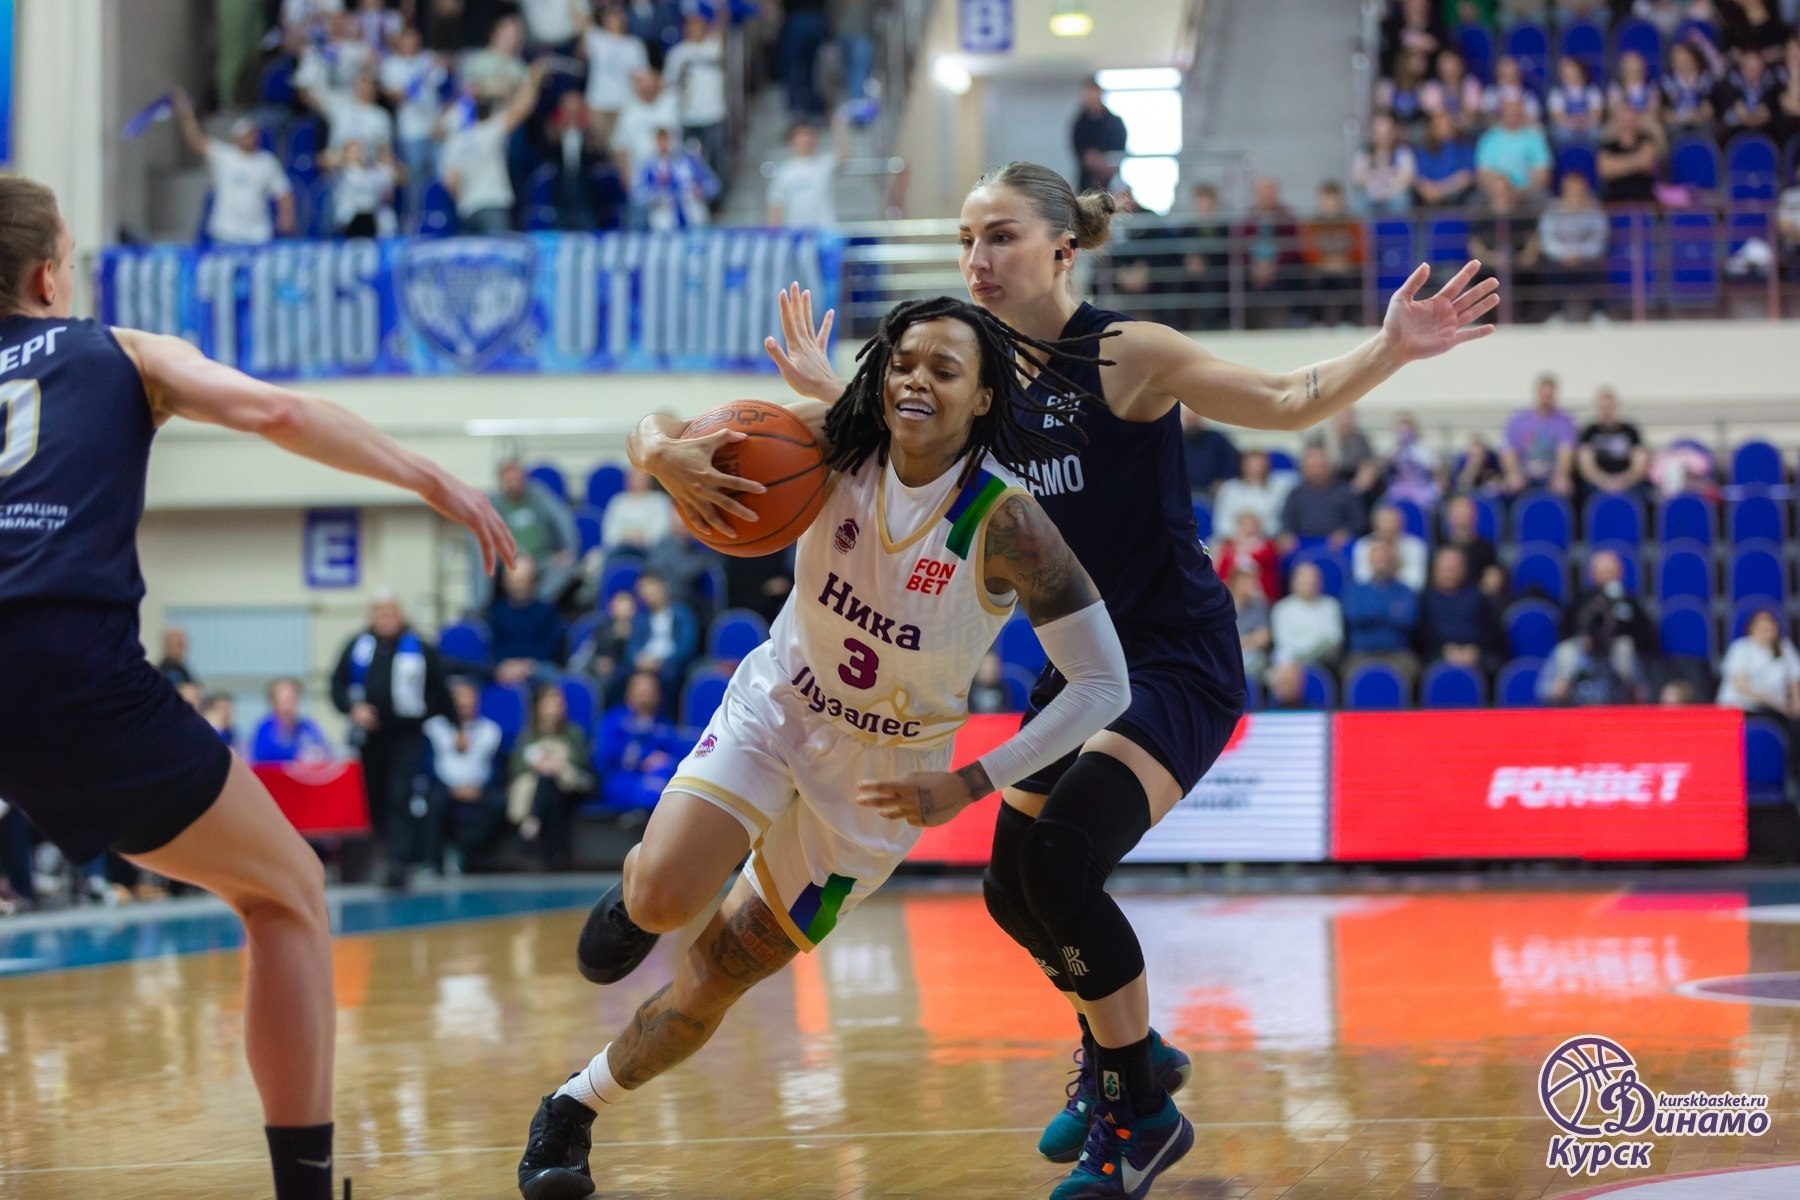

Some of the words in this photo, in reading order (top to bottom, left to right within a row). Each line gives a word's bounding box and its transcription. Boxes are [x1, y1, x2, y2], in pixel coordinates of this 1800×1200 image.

[905, 574, 950, 596] BET
[913, 558, 957, 580] FON
[818, 571, 922, 651] Ника
[837, 636, 880, 690] 3
[791, 665, 922, 738] Лузалес
